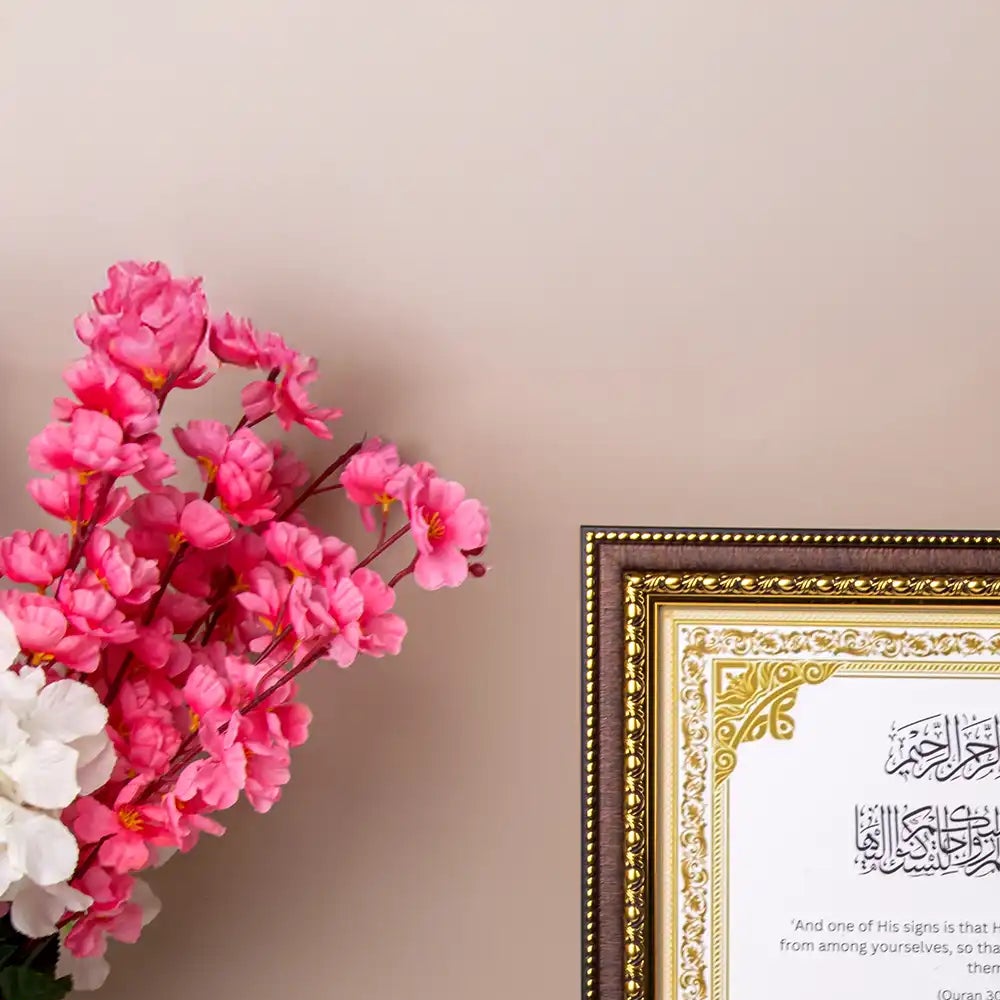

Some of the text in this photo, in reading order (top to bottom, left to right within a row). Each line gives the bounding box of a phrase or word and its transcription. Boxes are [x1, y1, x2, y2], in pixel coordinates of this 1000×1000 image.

[827, 921, 855, 933] one
[857, 919, 875, 933] of
[876, 919, 900, 933] His
[902, 919, 941, 937] signs
[942, 920, 956, 934] is
[958, 920, 989, 935] that
[779, 938, 815, 952] from
[818, 941, 869, 956] among
[869, 940, 953, 957] yourselves,
[956, 943, 974, 955] so
